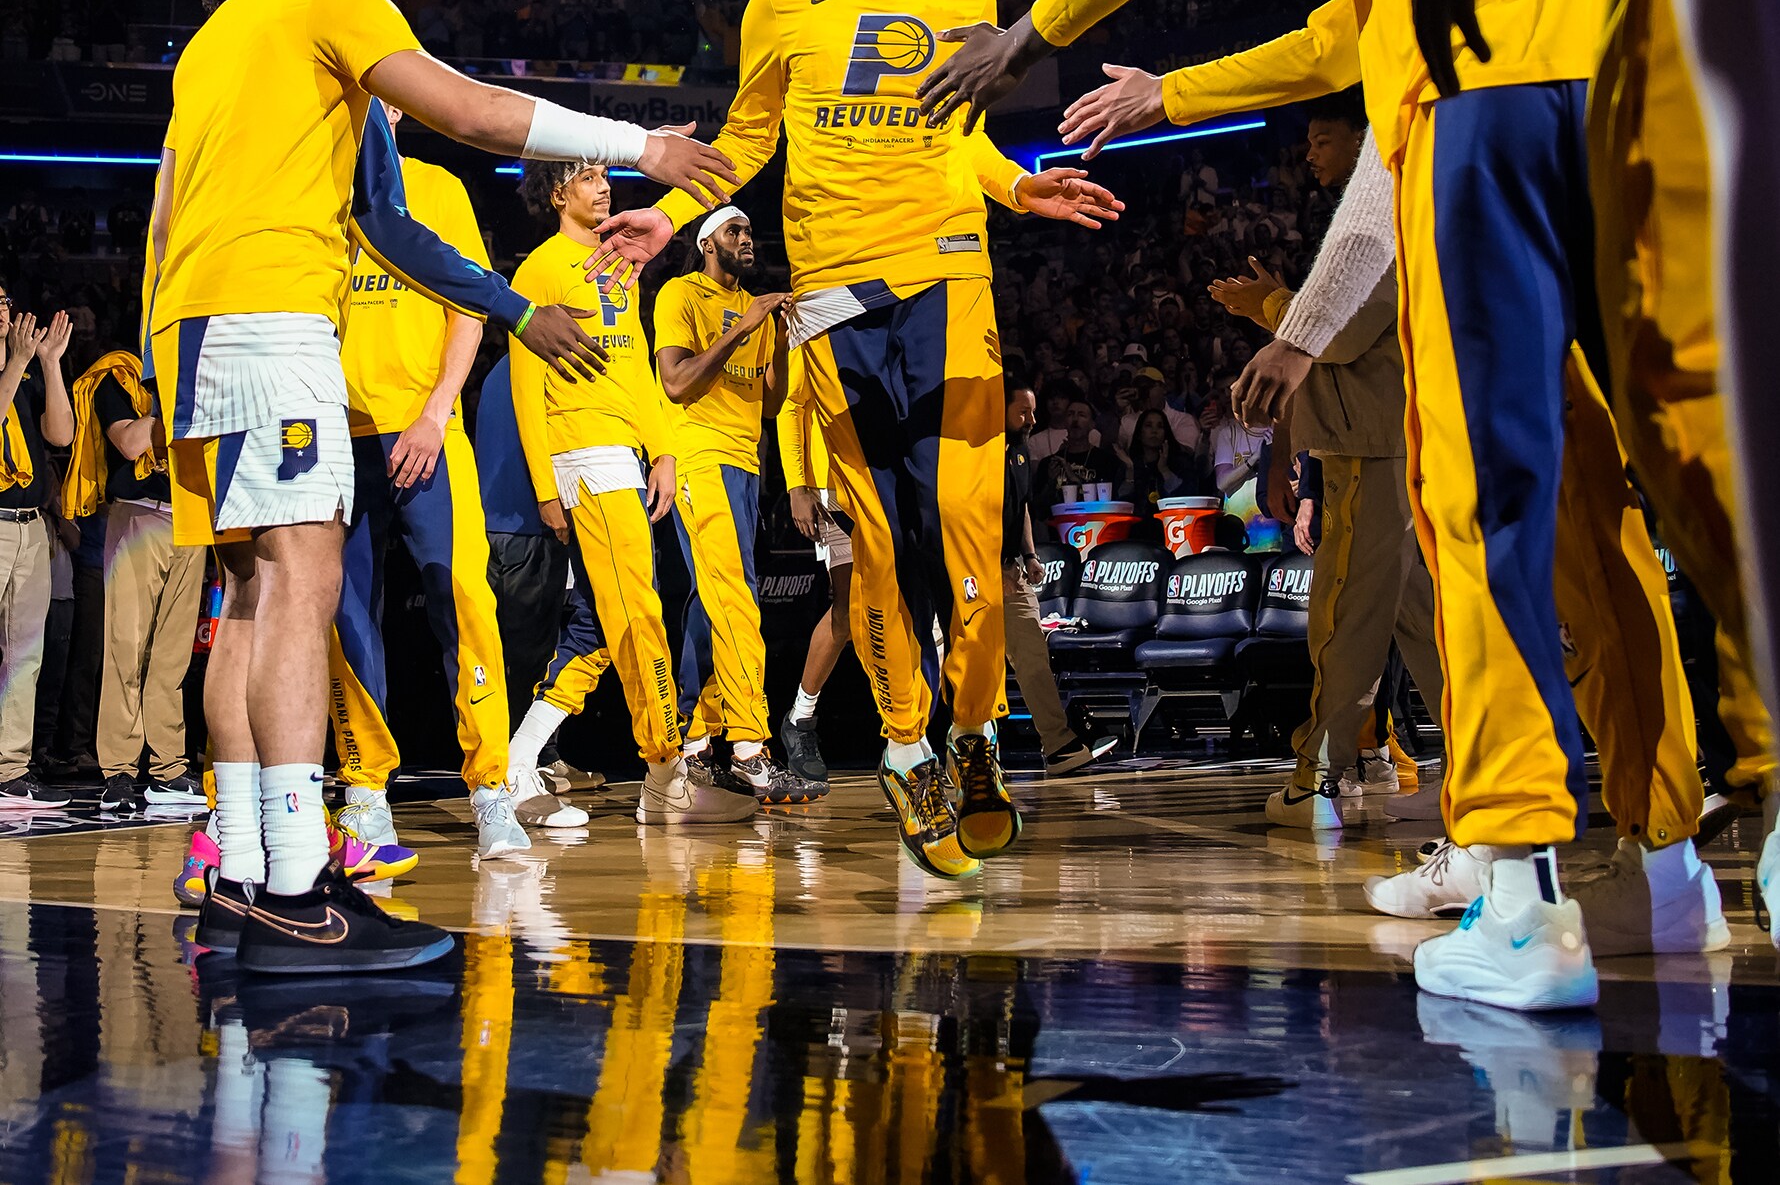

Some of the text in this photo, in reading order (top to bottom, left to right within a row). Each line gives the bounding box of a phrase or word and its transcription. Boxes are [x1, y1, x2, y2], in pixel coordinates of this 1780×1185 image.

[593, 95, 723, 124] KeyBank
[814, 105, 921, 128] REVVED
[1167, 520, 1185, 544] G
[1093, 561, 1160, 584] PLAYOFFS
[1179, 570, 1248, 598] PLAYOFFS
[760, 574, 815, 596] PLAYOFFS
[1098, 584, 1120, 592] Google
[1185, 598, 1207, 606] Google
[867, 605, 894, 713] INDIANA PACERS
[653, 657, 677, 743] INDIANA PACERS
[331, 677, 362, 772] INDIANA PACERS
